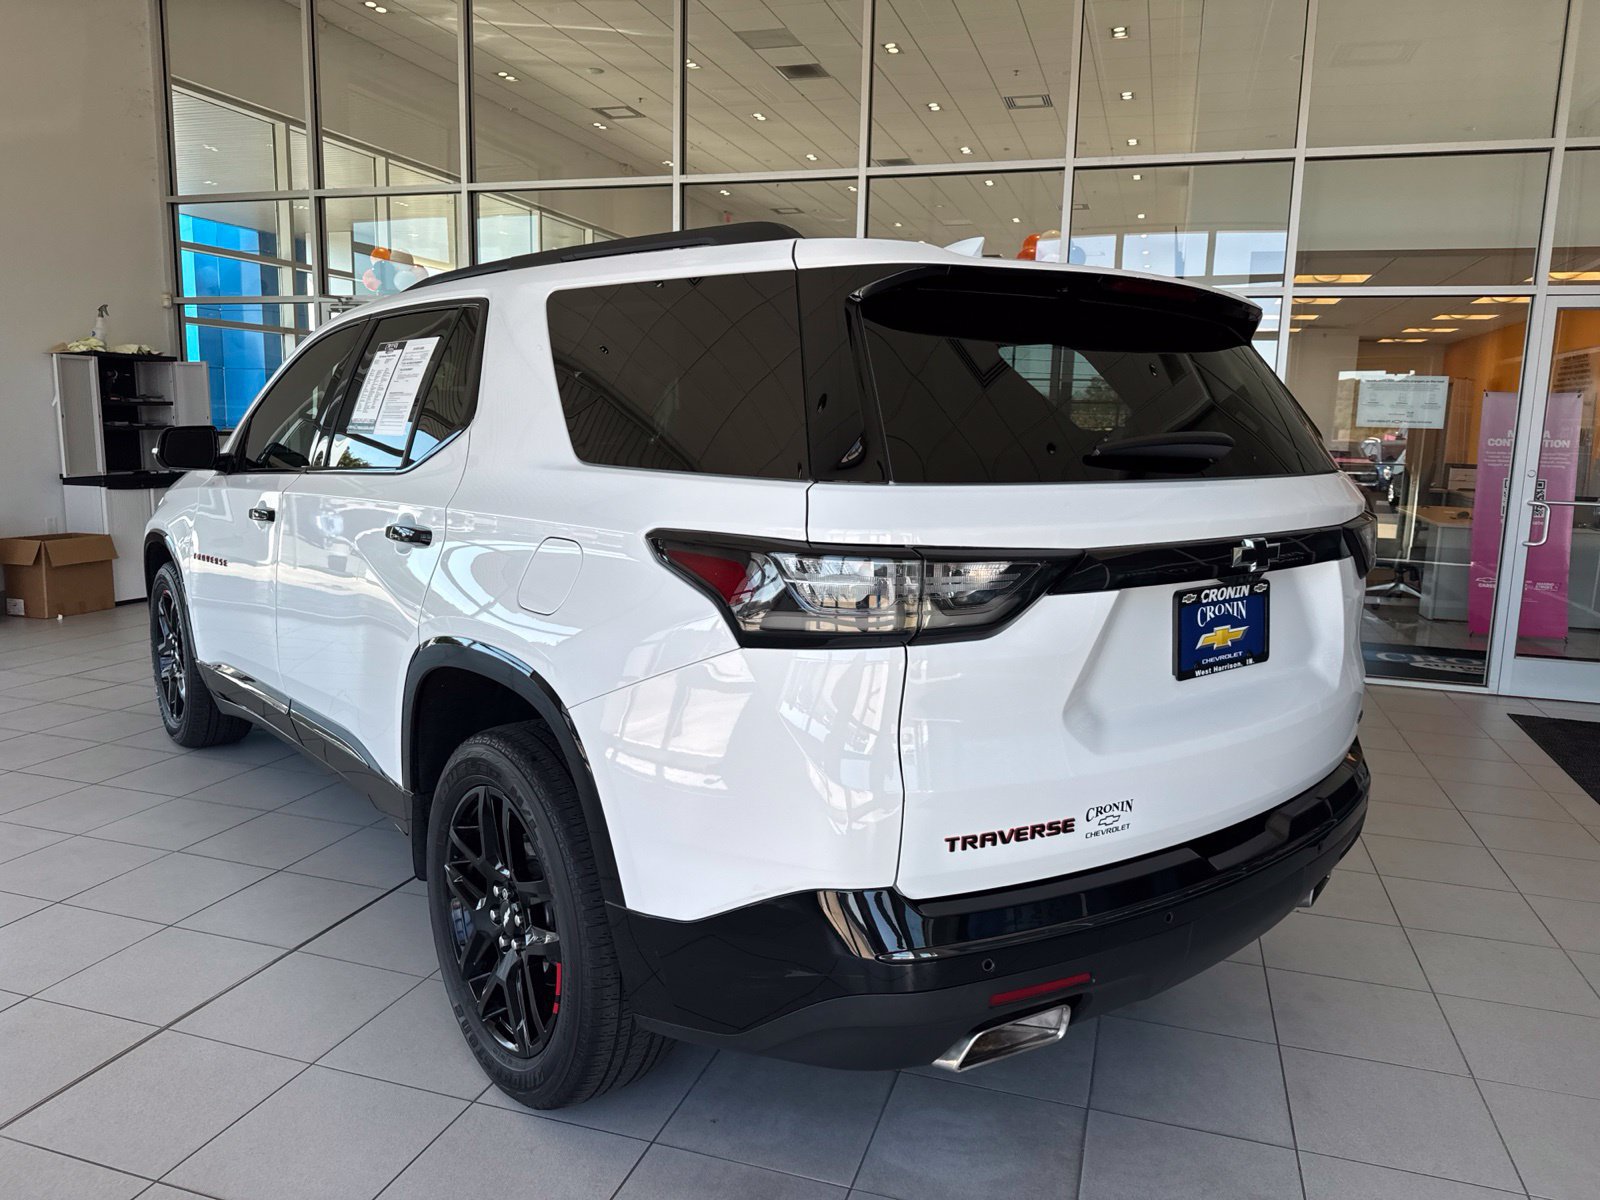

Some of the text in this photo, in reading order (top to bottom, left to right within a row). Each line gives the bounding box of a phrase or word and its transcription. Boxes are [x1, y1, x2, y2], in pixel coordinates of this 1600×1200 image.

[1201, 584, 1250, 604] CRONIN
[1197, 600, 1247, 627] CRONIN
[1202, 651, 1243, 664] CHEVROLET
[1194, 664, 1212, 677] West
[1085, 799, 1134, 823] CRONIN
[944, 817, 1076, 853] TRAVERSE
[1085, 822, 1131, 839] CHEVROLET
